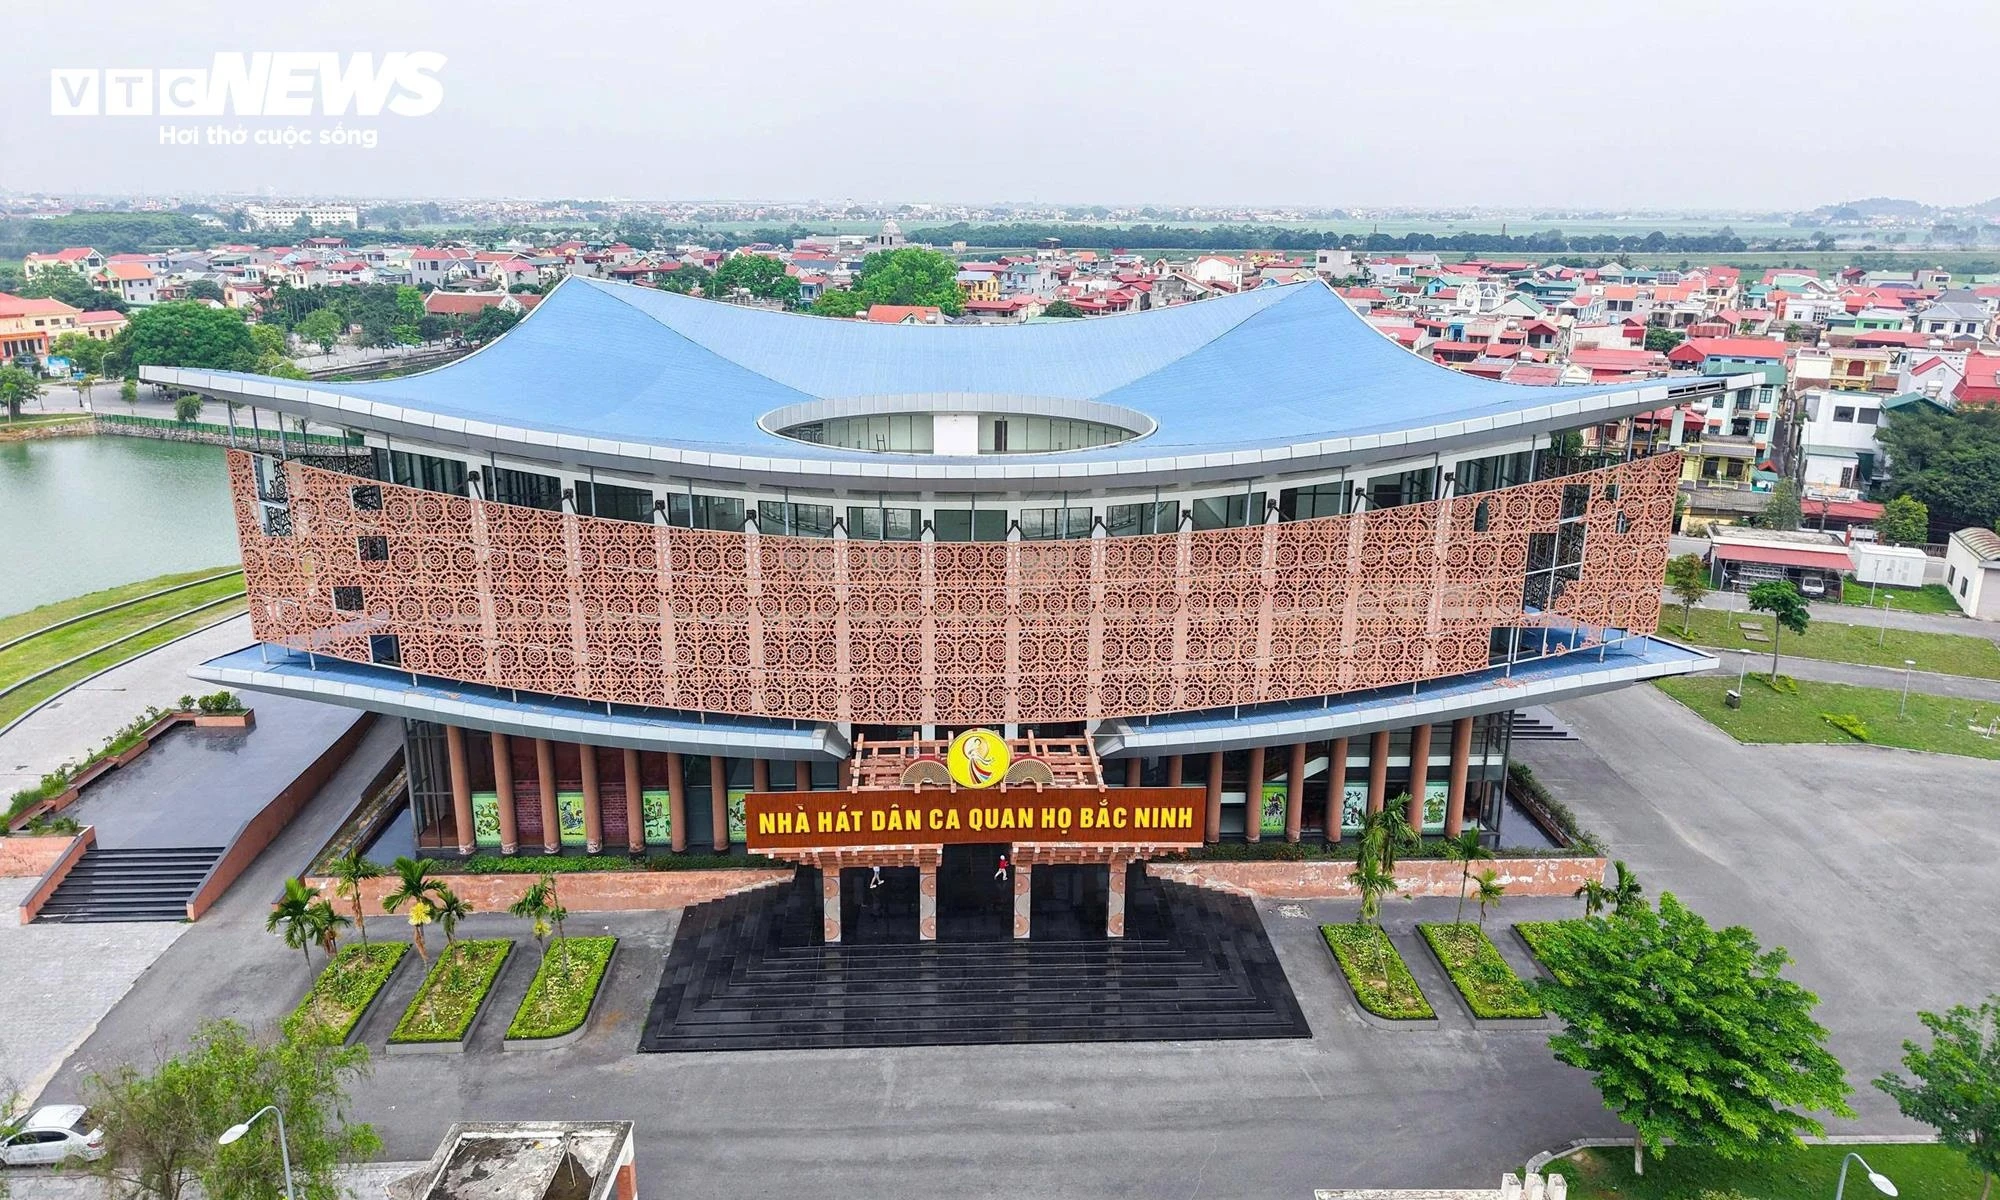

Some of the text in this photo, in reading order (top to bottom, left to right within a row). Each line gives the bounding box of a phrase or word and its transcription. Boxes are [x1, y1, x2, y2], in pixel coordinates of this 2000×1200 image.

[759, 798, 1193, 835] NHÀ HÁT DÂN CA QUAN HỌ BẮC NINH
